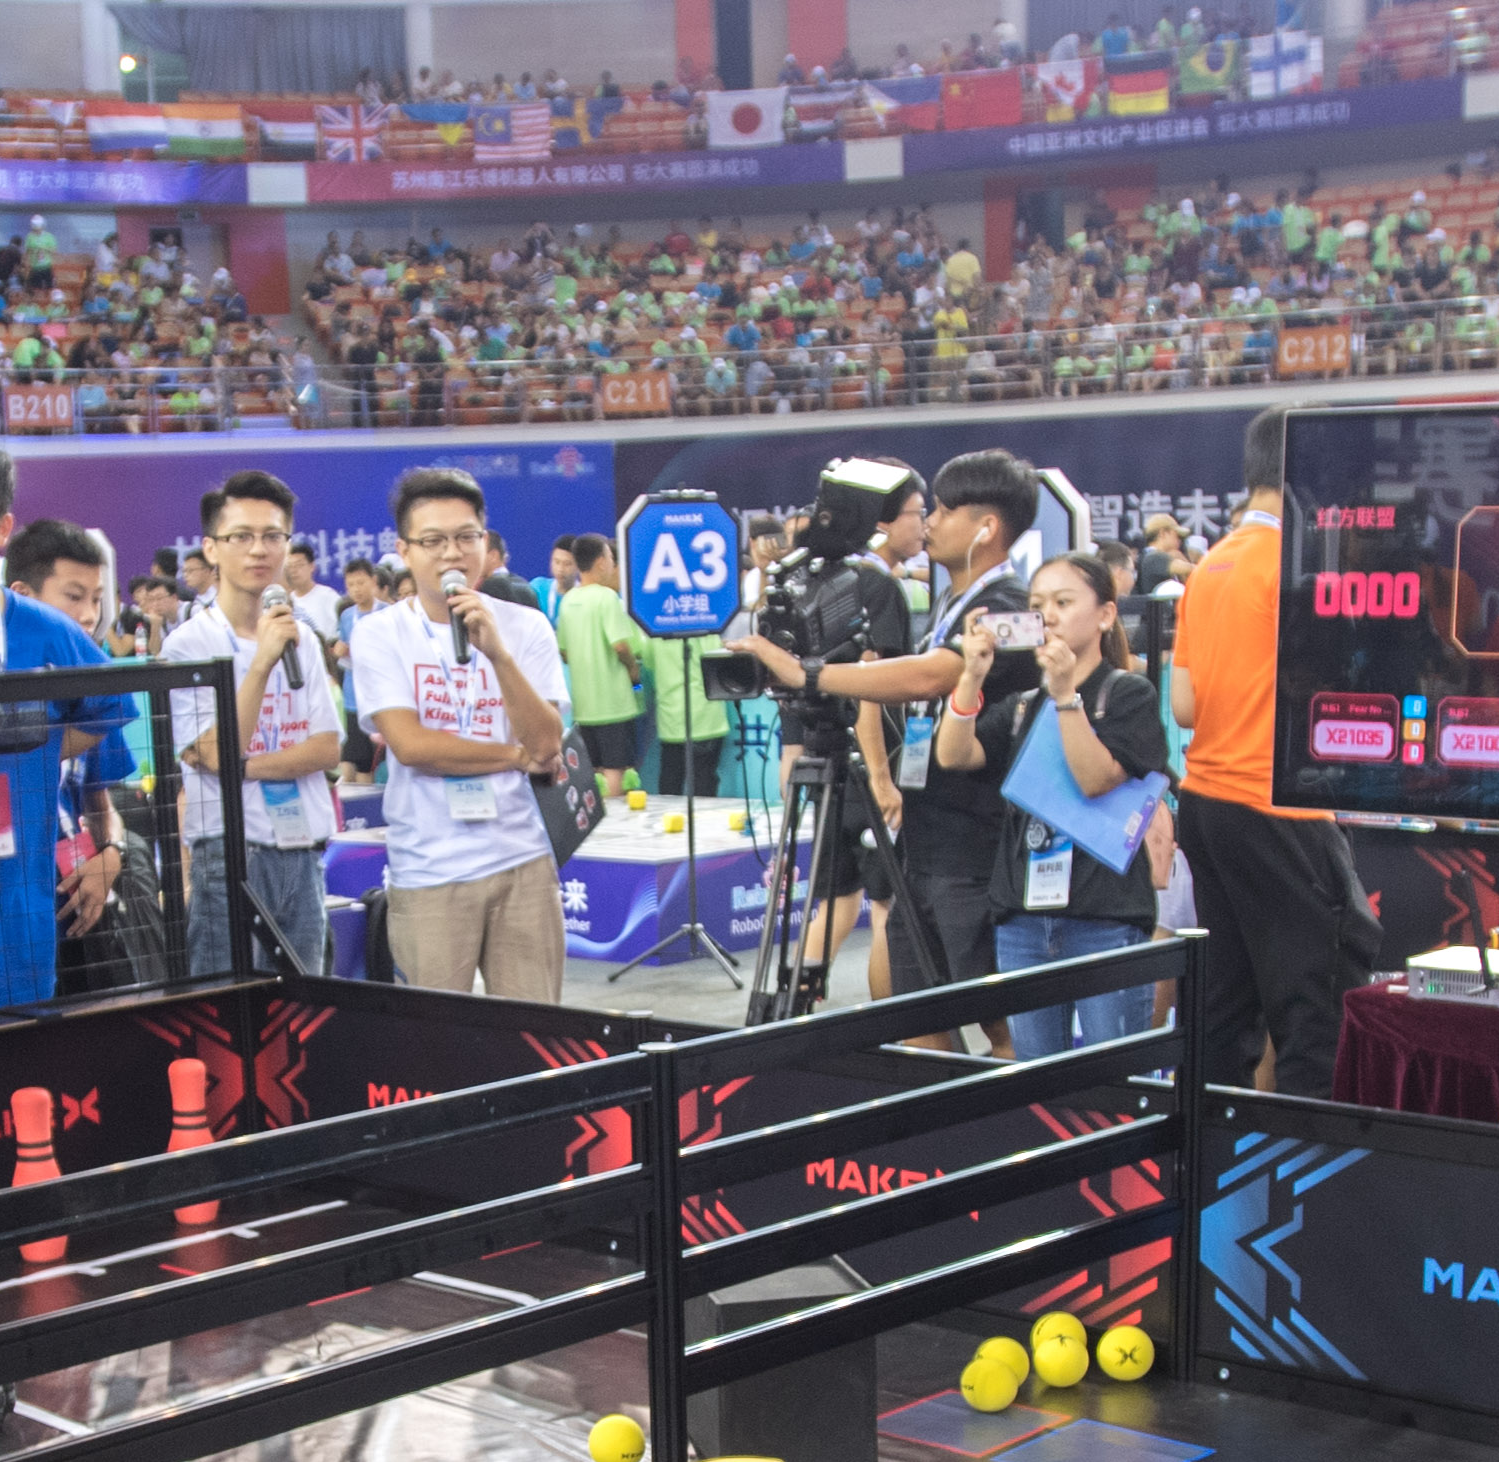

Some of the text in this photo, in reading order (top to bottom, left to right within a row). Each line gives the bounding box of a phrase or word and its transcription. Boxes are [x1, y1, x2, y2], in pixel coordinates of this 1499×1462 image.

[1281, 334, 1347, 365] C212
[604, 379, 668, 405] C211
[7, 393, 69, 420] B210
[1315, 506, 1396, 529] 红方联盟
[642, 530, 729, 593] A3
[662, 593, 710, 613] 小学组
[1313, 571, 1421, 618] 0000
